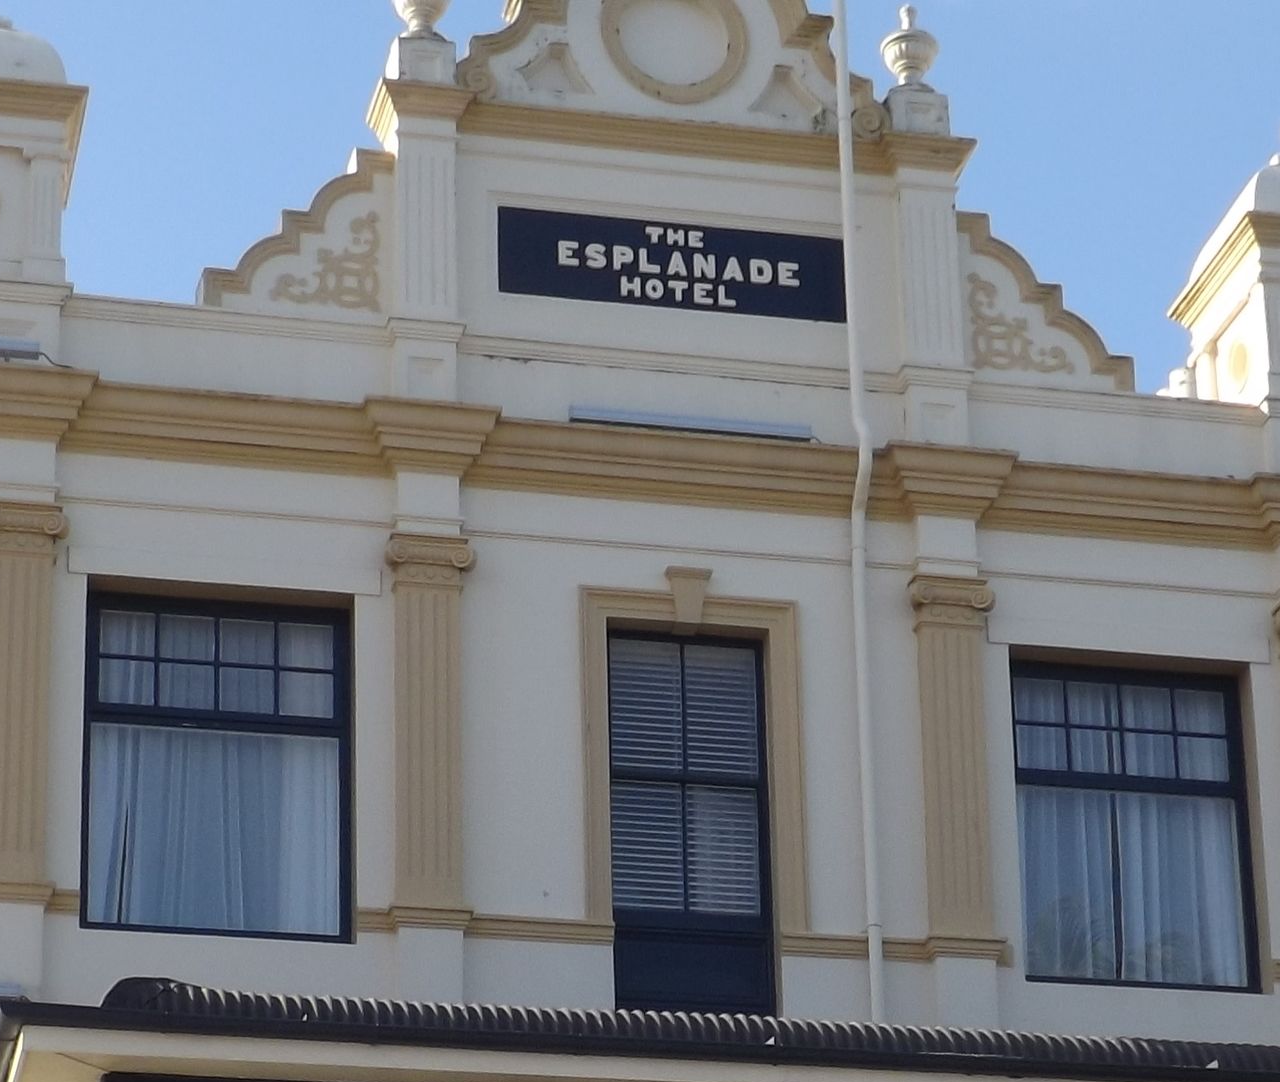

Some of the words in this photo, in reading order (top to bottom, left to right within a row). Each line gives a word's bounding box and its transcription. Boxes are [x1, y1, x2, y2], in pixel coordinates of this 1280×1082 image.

[644, 225, 704, 249] THE
[556, 240, 801, 287] ESPLANADE
[619, 276, 737, 308] HOTEL
